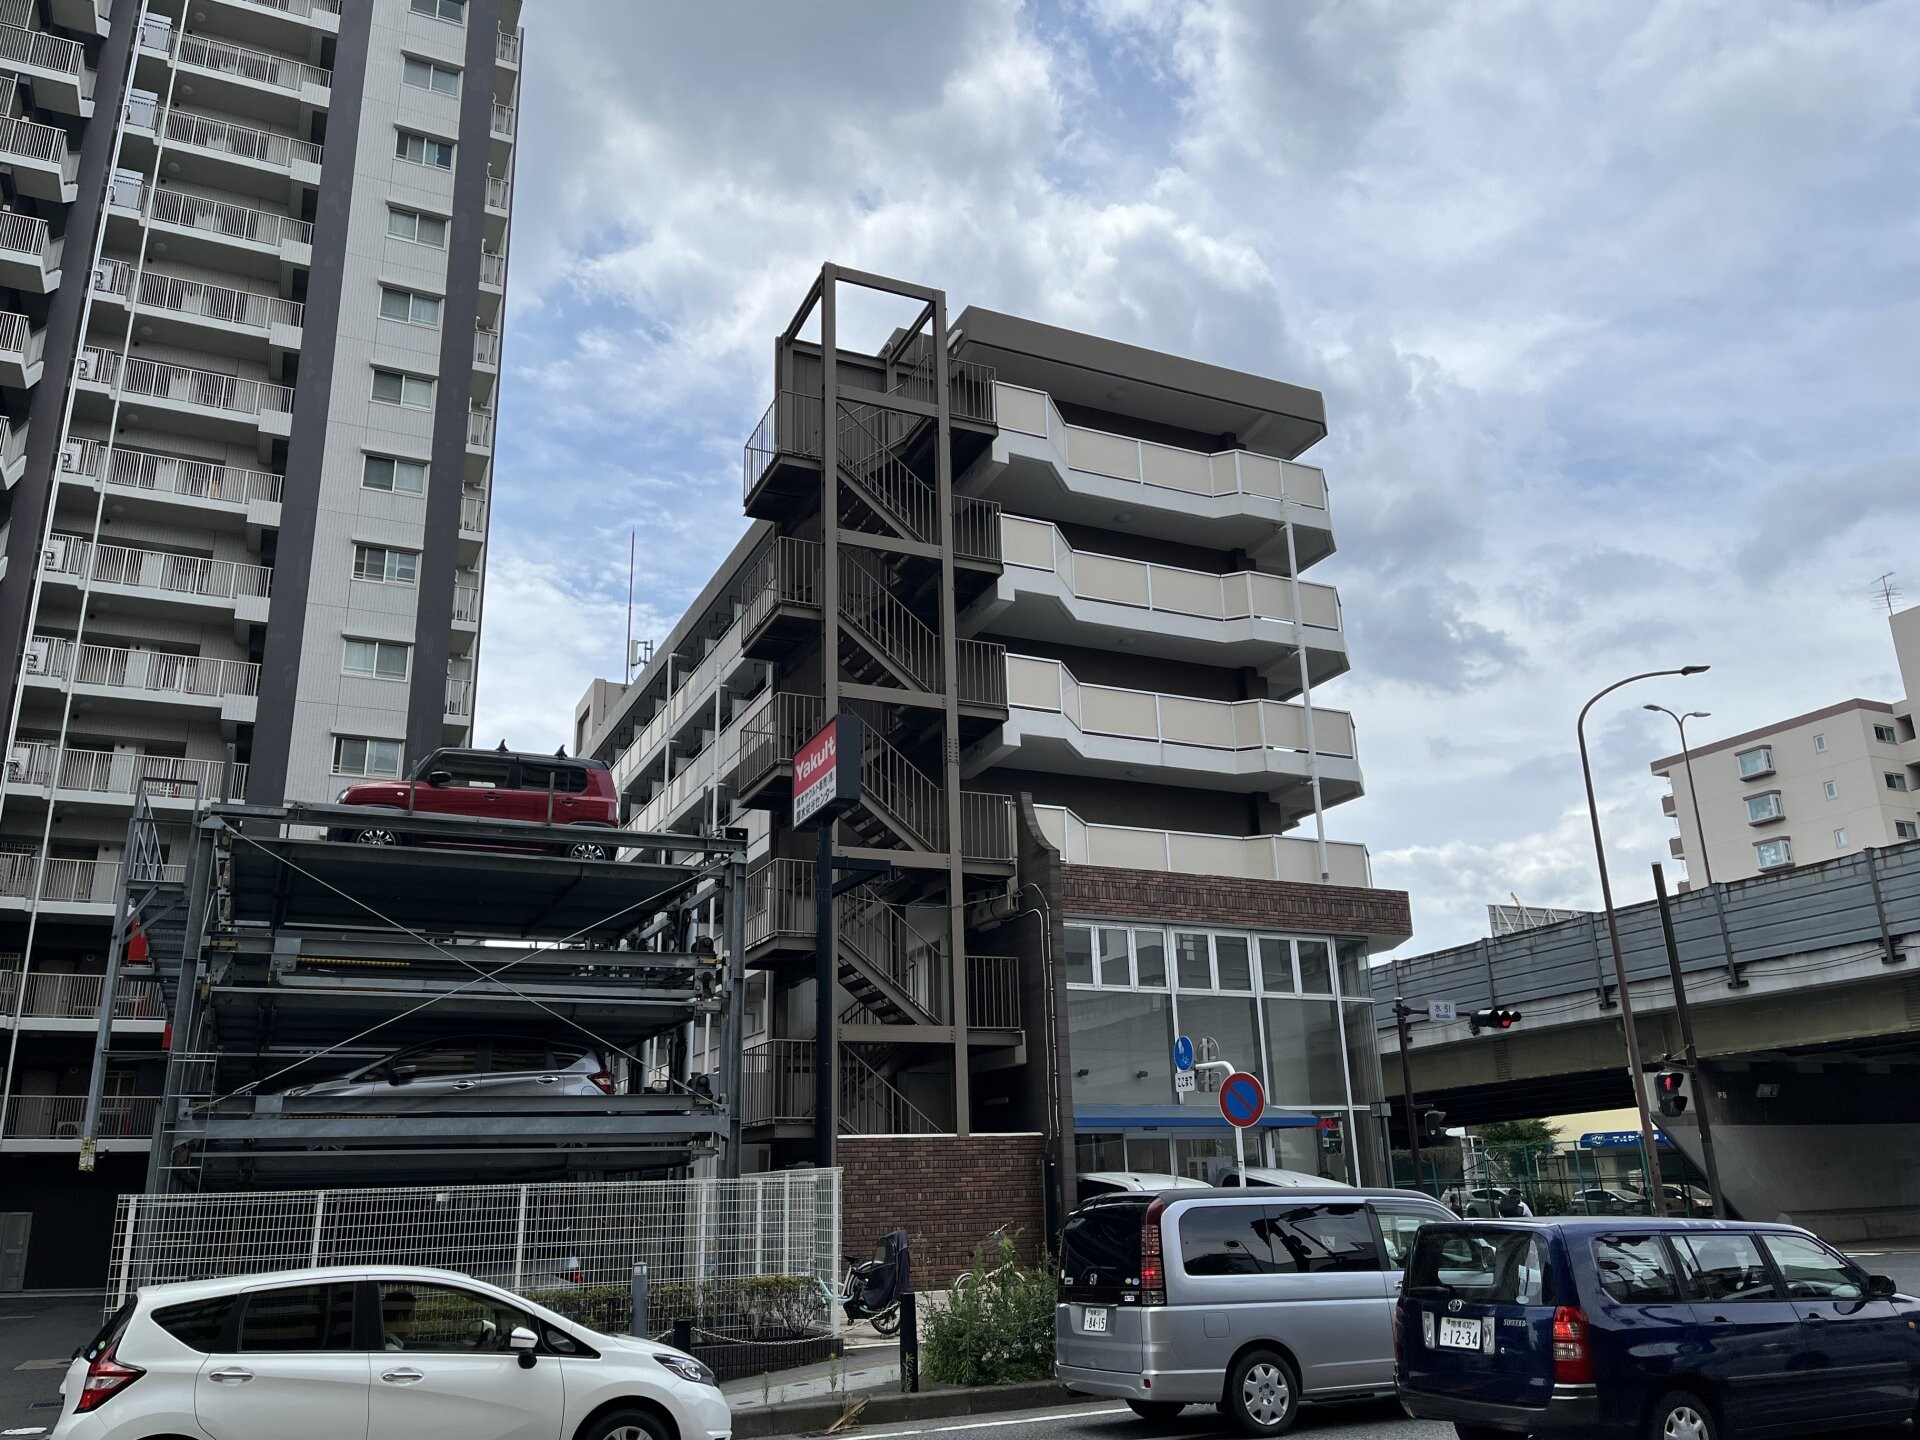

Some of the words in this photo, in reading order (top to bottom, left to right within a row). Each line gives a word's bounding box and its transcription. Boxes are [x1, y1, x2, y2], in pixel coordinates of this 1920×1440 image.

[796, 736, 836, 782] Yakult
[1434, 1003, 1451, 1013] 水引
[1088, 1317, 1105, 1330] 84-15
[1450, 1330, 1477, 1347] 12-34
